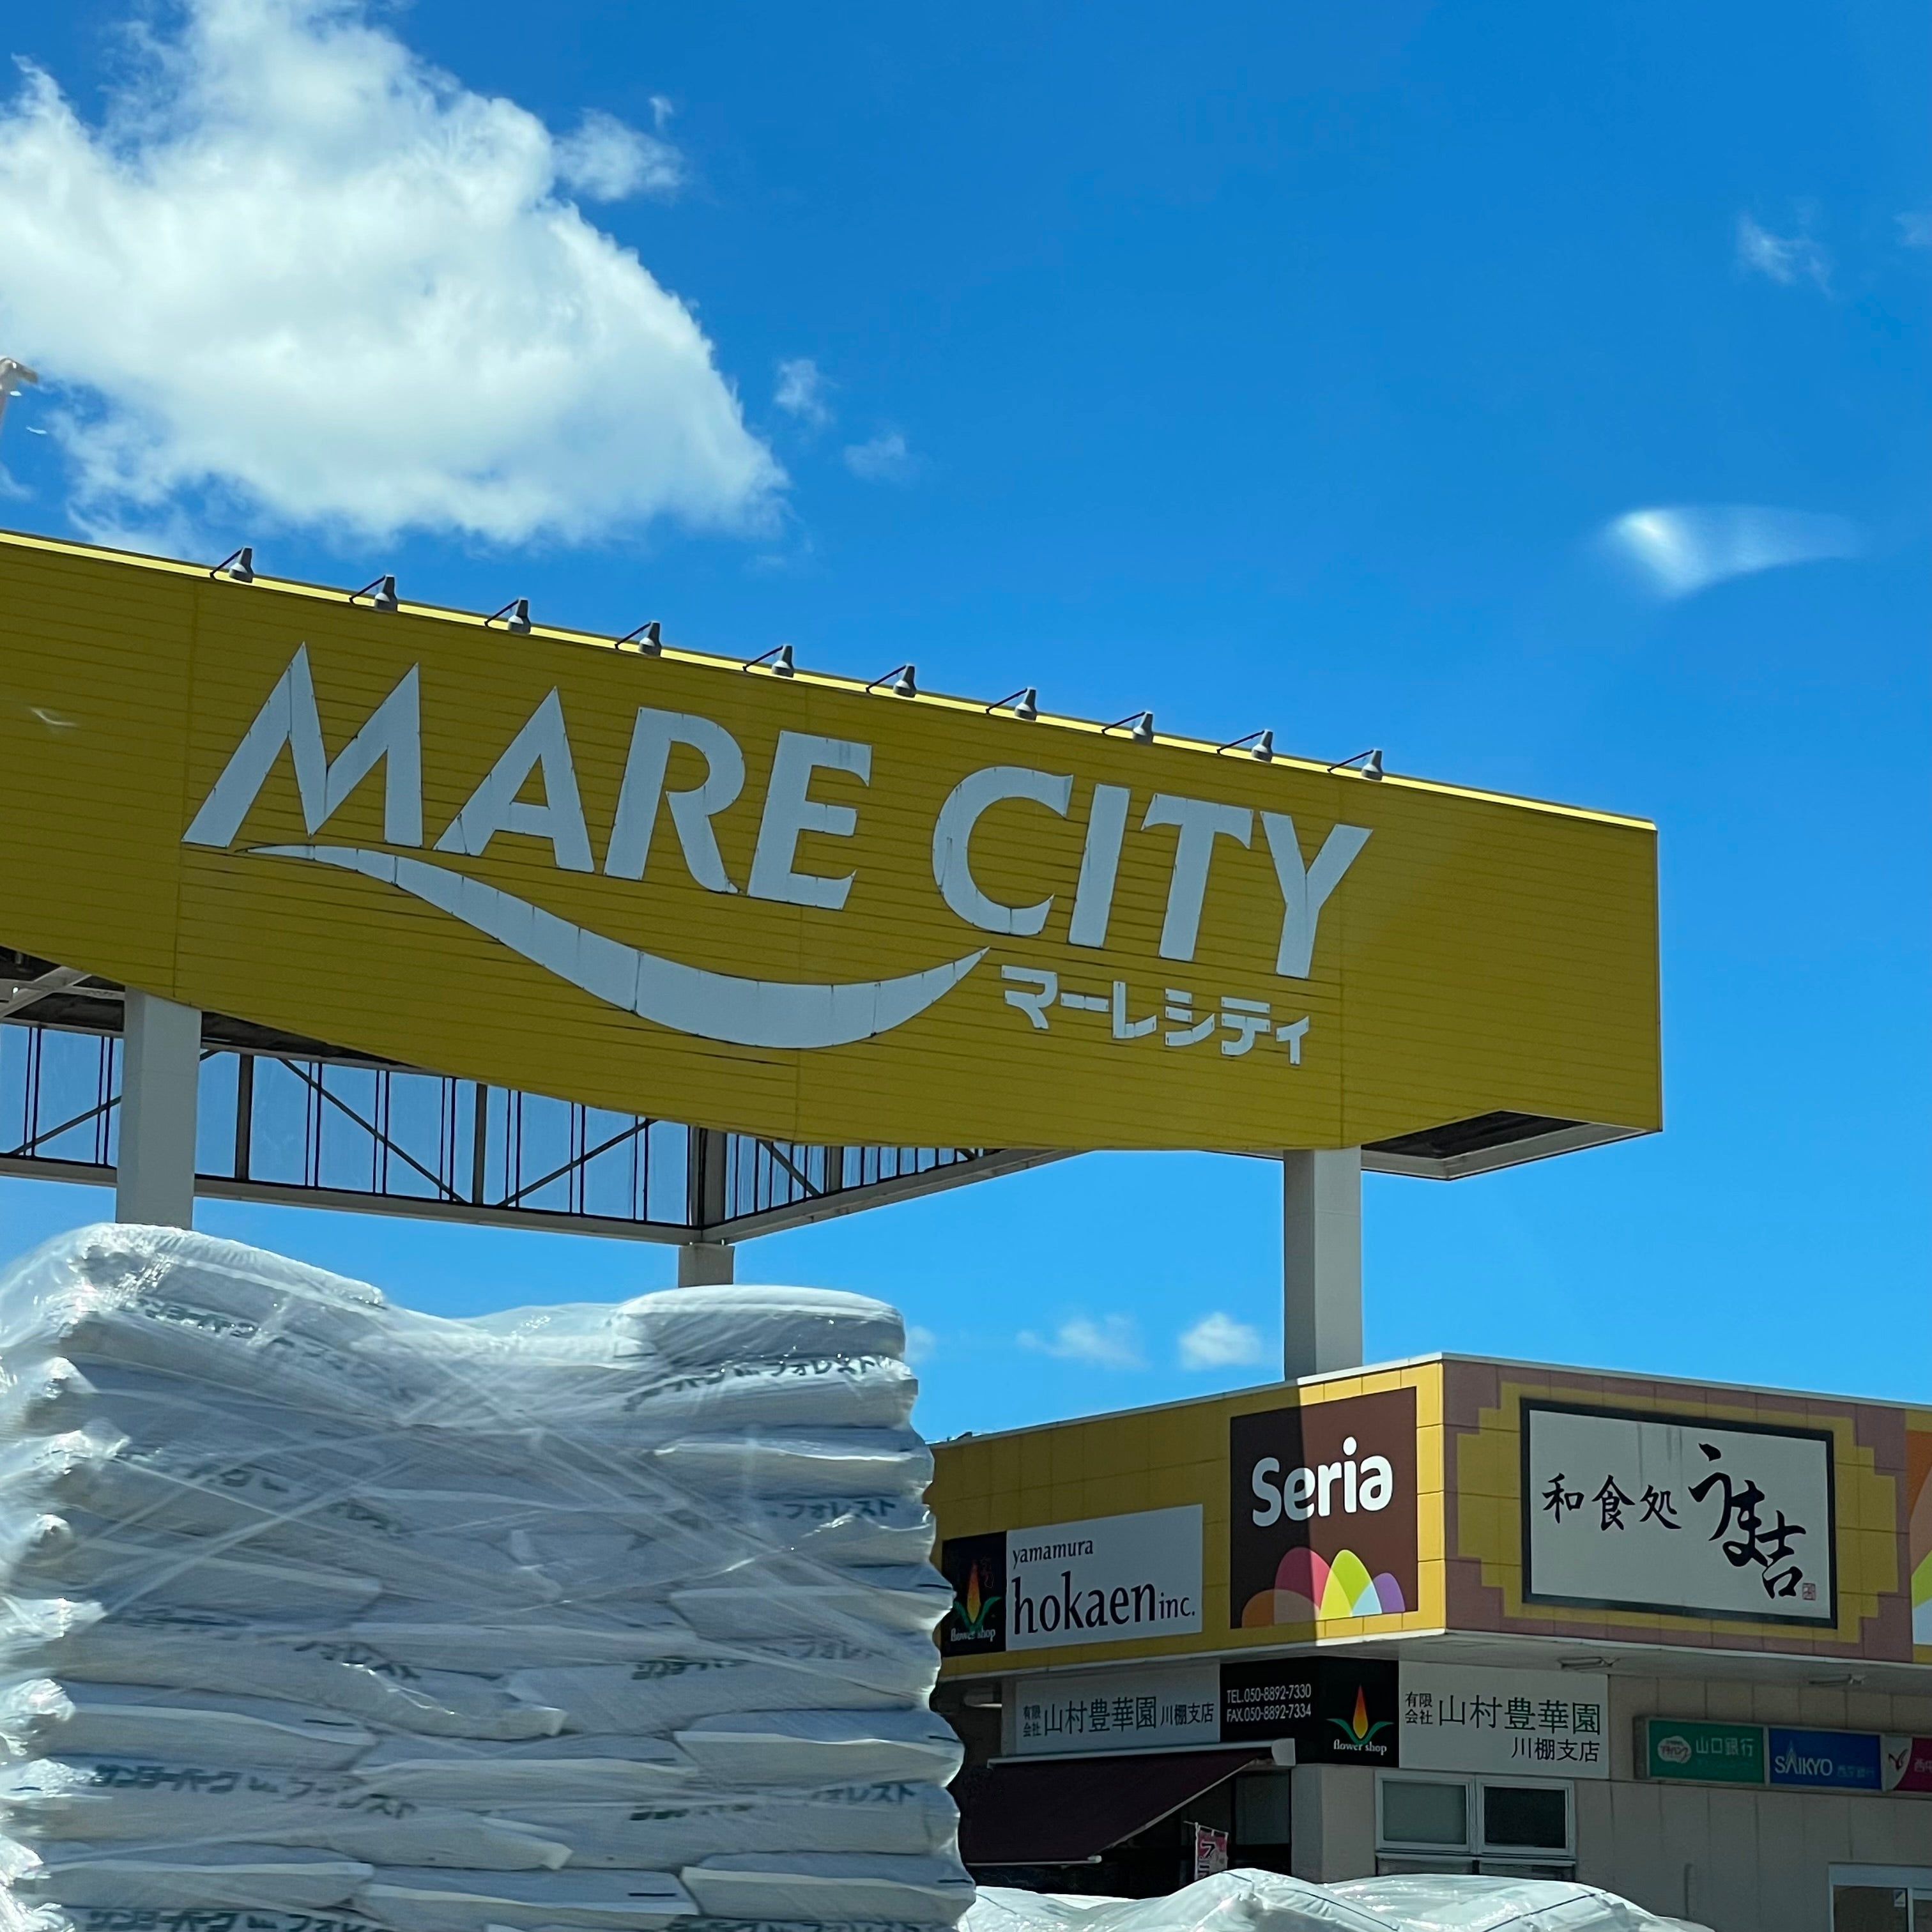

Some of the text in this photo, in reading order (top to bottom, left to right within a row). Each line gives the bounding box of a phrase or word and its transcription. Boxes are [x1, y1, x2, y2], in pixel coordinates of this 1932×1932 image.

[182, 642, 1373, 979] MARE CITY
[1001, 965, 1309, 1064] マーレシティ
[1252, 1437, 1393, 1526] Seria
[1542, 1443, 1807, 1599] 和食処 うま吉
[1012, 1539, 1094, 1569] yamamura
[1011, 1570, 1195, 1635] hokaen inc.
[977, 1626, 996, 1642] shop
[1227, 1683, 1312, 1704] TEL.050-8892-7330
[1405, 1691, 1433, 1708] 有限
[1044, 1696, 1215, 1736] 山村豊華園 川棚支店
[1405, 1708, 1434, 1725] 会社
[1439, 1694, 1600, 1736] 山村豊華園
[1333, 1739, 1387, 1756] flower shop
[1512, 1736, 1600, 1763] 川棚支店
[1696, 1736, 1754, 1757] 山口銀行
[1775, 1746, 1833, 1777] SAIKYO
